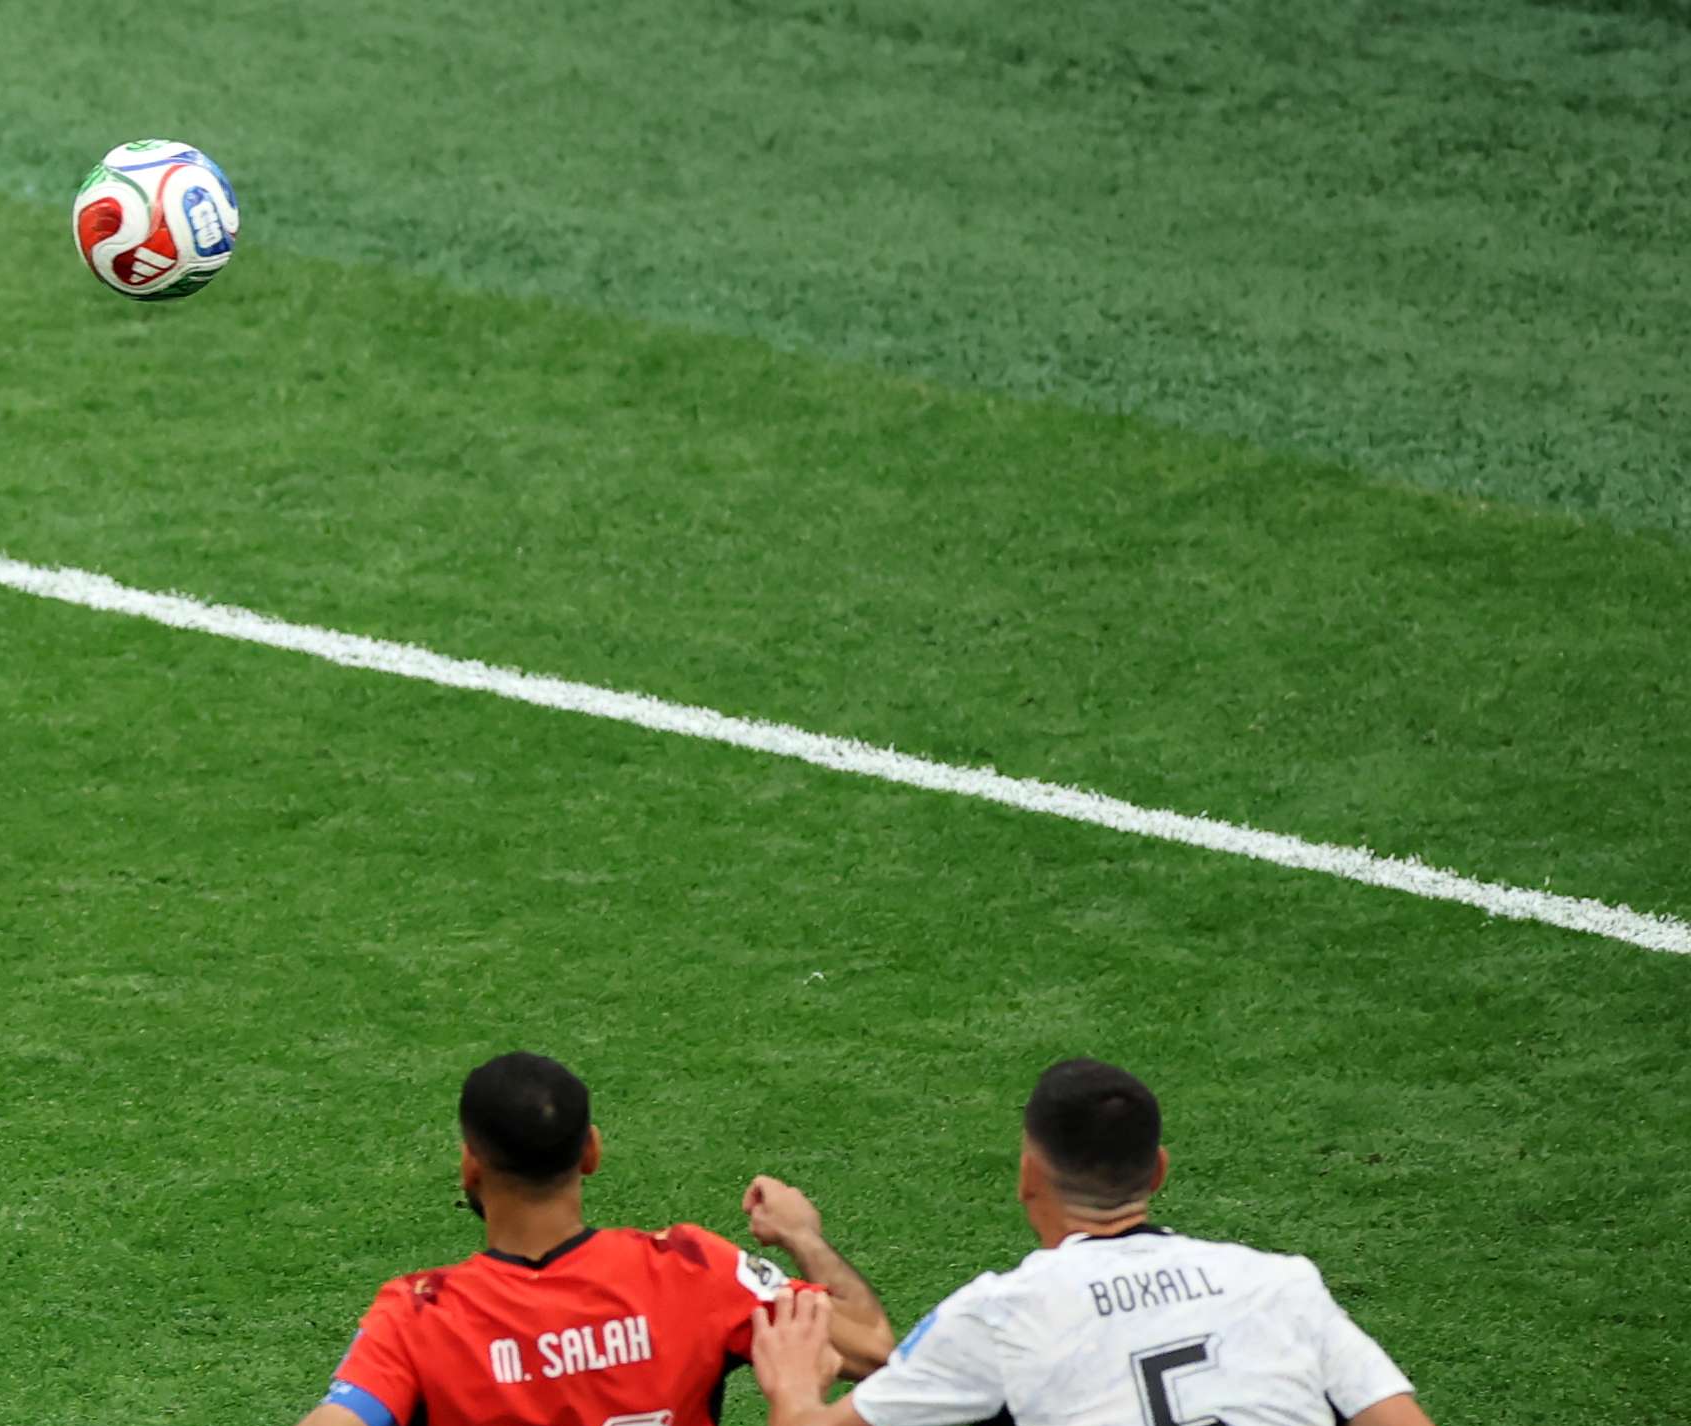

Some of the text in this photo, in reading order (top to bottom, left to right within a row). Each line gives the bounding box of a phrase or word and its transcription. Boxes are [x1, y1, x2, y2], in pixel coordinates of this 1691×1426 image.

[1088, 1266, 1224, 1317] BOXALL
[489, 1315, 652, 1384] M. SALAH
